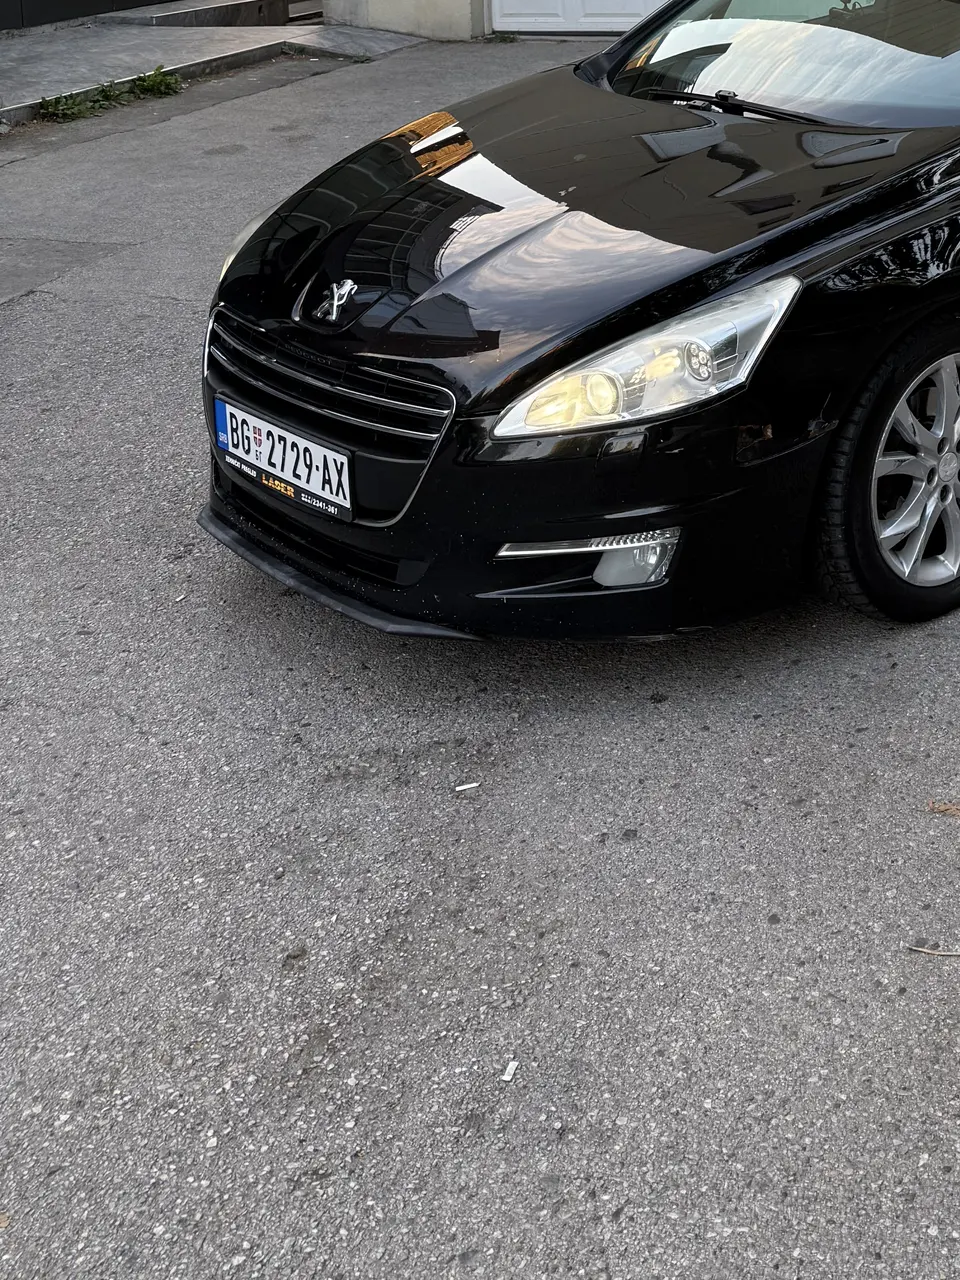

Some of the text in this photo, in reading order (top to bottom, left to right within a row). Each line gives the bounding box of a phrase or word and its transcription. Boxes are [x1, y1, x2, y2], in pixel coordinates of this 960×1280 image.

[284, 343, 333, 365] PEUGEOT
[229, 411, 251, 456] BG
[261, 473, 295, 498] LASER
